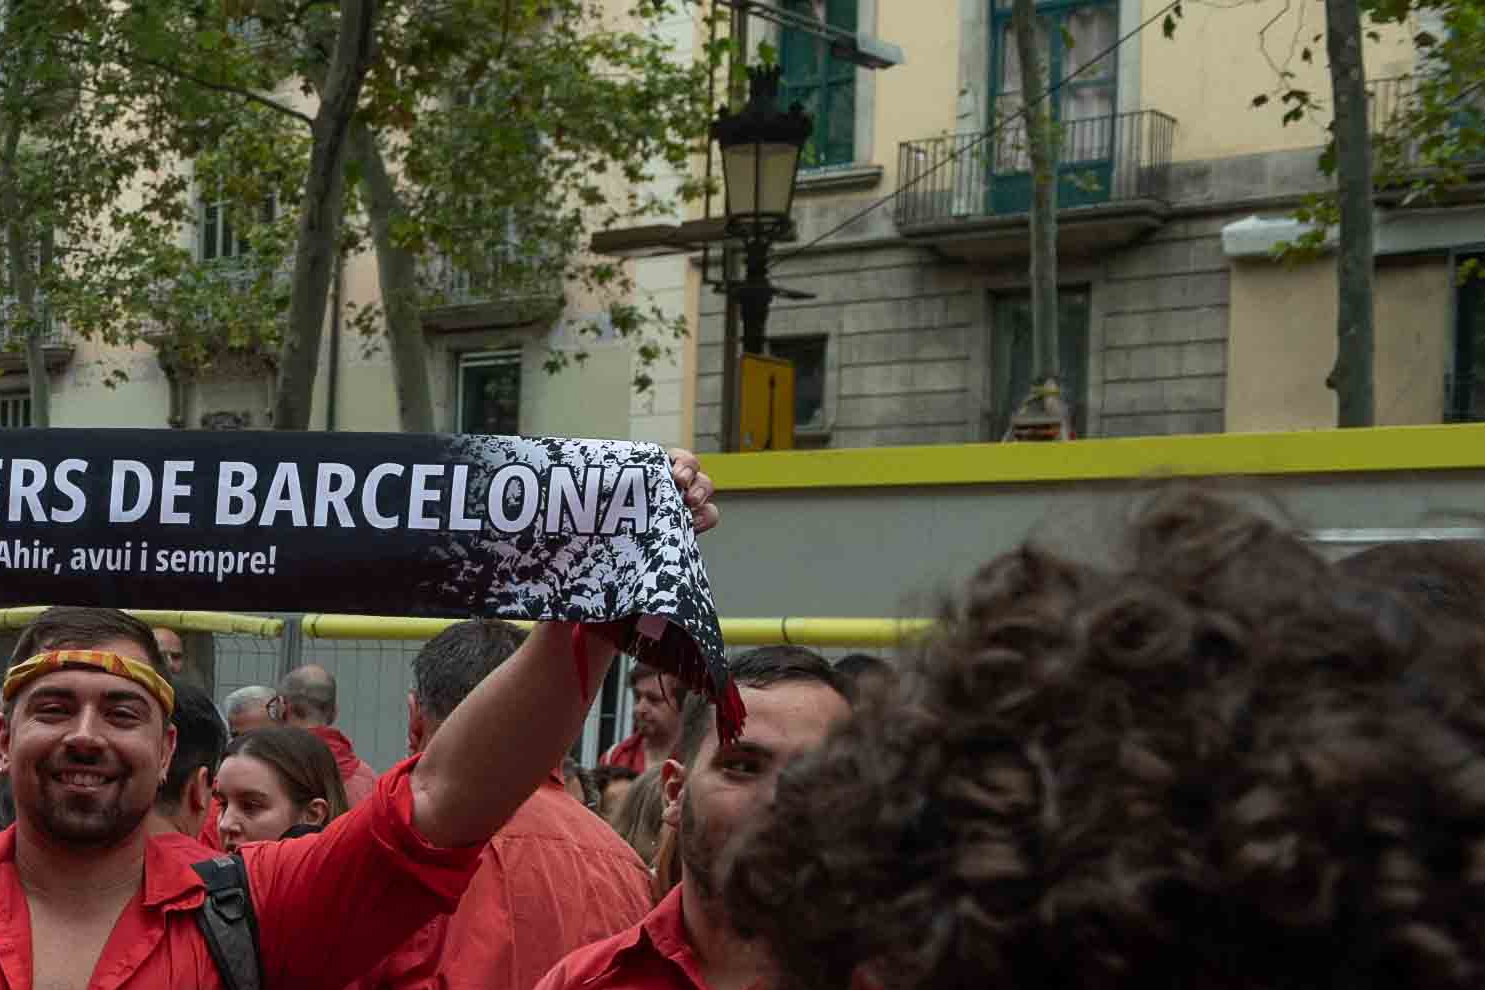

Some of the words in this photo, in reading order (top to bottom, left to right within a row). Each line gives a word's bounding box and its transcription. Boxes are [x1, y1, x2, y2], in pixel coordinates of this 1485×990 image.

[109, 459, 195, 524] DE
[215, 461, 650, 535] BARCELONA
[70, 541, 132, 571] avui
[140, 541, 148, 571] i
[155, 545, 276, 582] sempre!
